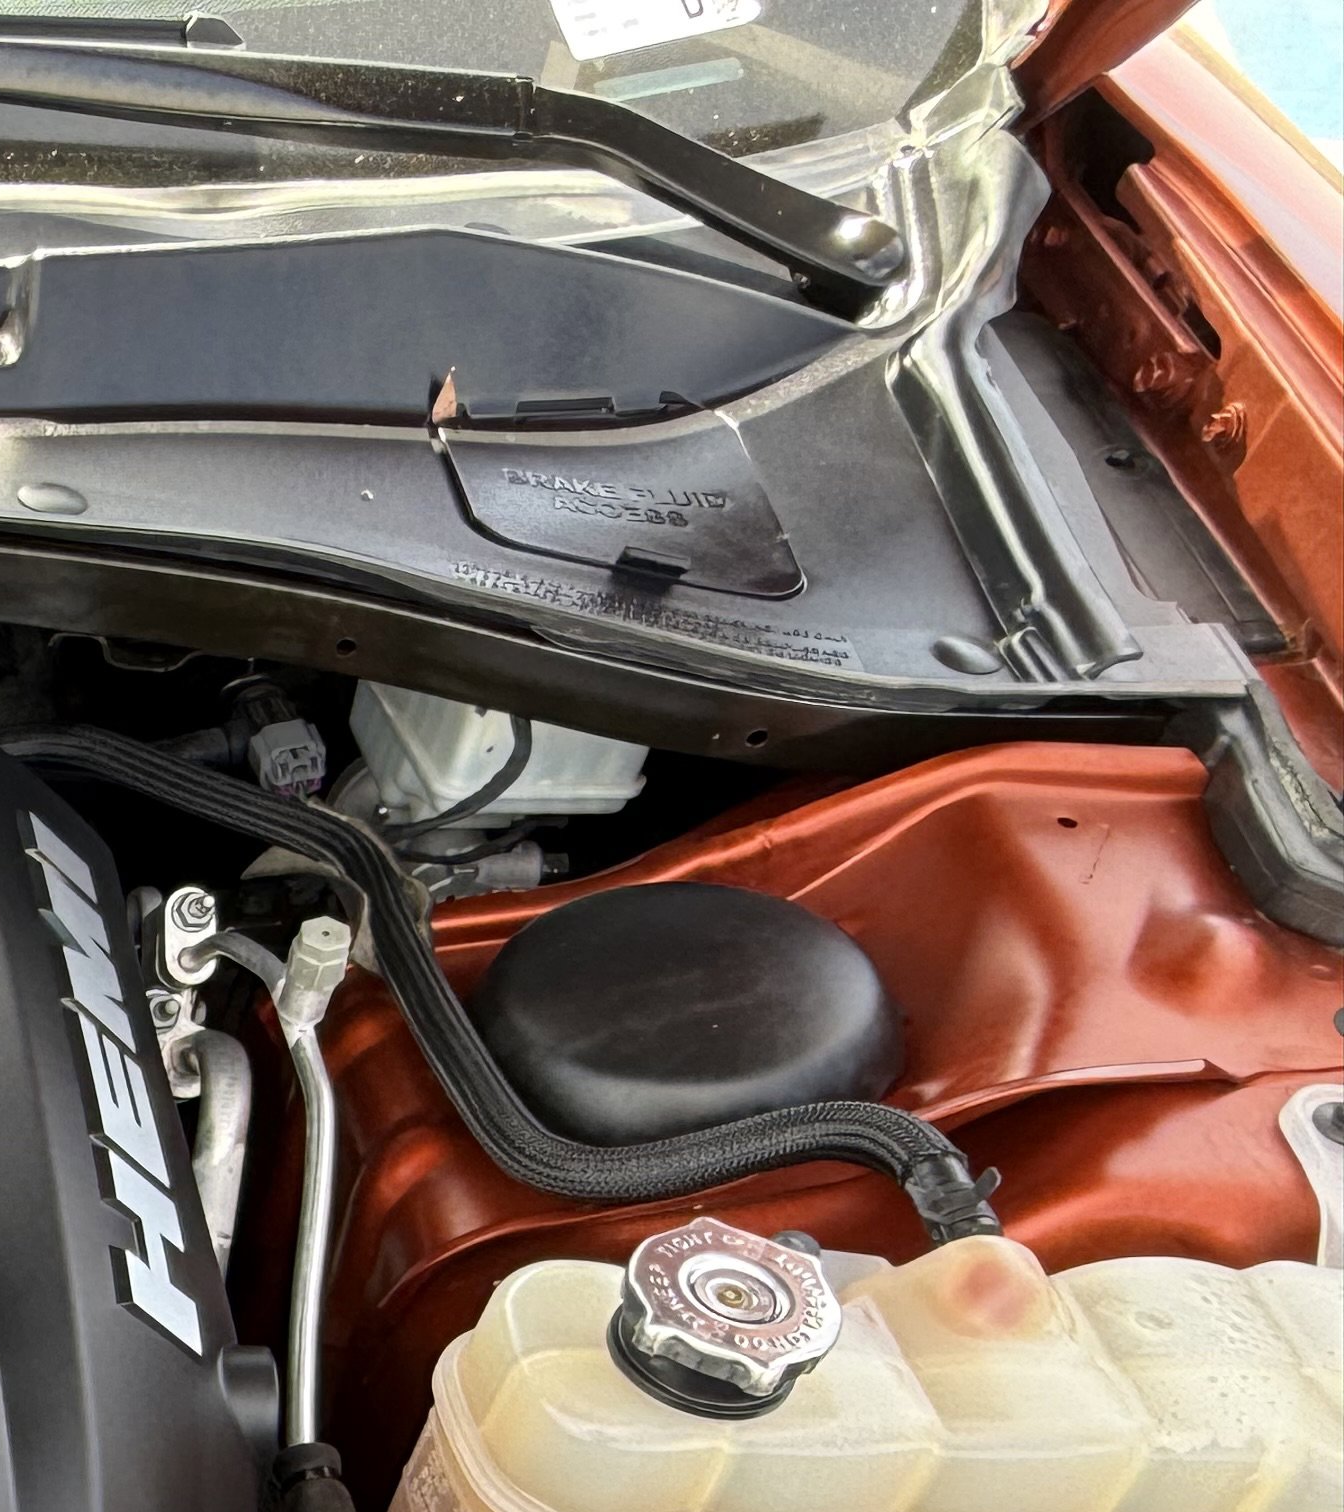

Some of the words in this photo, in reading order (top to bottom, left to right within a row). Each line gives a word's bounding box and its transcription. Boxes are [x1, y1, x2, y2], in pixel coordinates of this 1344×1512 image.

[502, 467, 622, 501] BRAKE
[628, 486, 733, 512] FLUID
[553, 496, 690, 528] ACCESS
[28, 810, 203, 1358] HEMI
